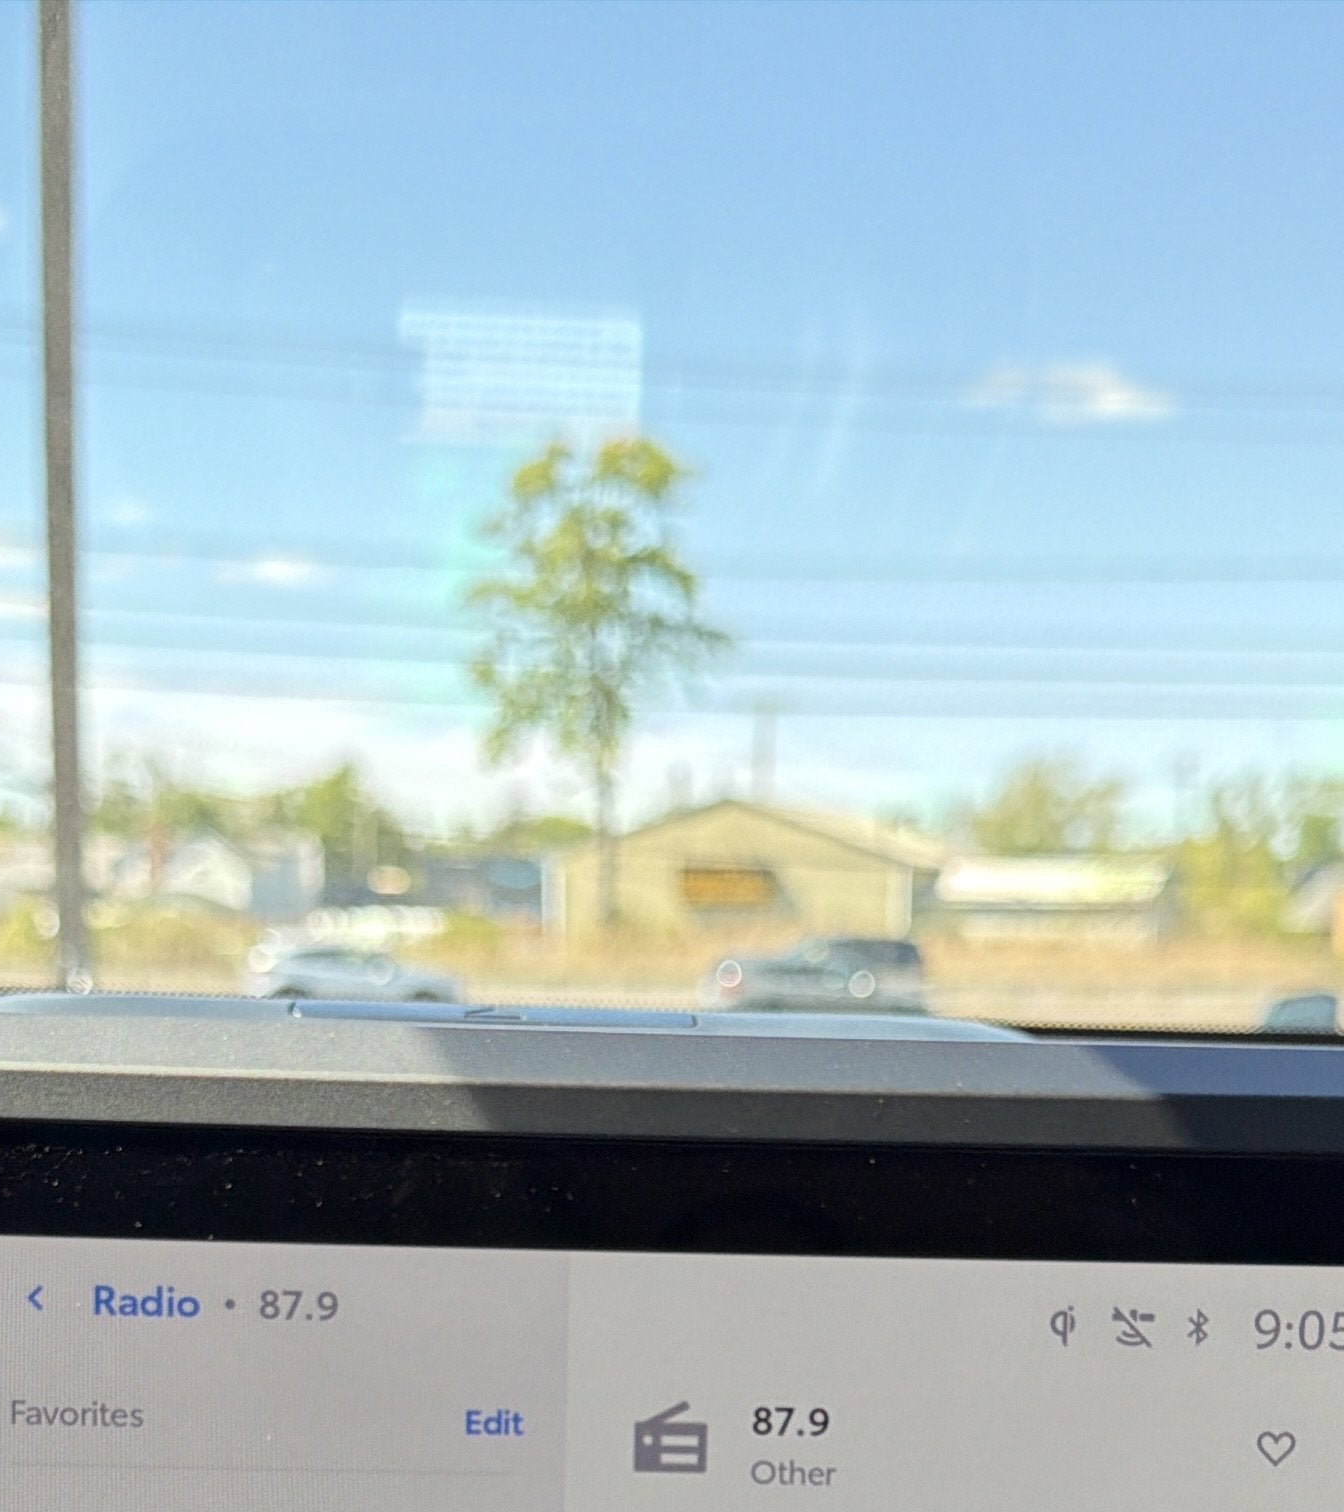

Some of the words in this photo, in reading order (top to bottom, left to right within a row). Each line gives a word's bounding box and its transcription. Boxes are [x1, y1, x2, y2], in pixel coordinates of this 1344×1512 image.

[94, 1284, 201, 1318] Radio
[258, 1289, 340, 1322] 87.9
[10, 1399, 144, 1429] Favorites
[465, 1410, 524, 1437] Edit
[751, 1406, 830, 1438] 87.9
[750, 1460, 837, 1487] Other
